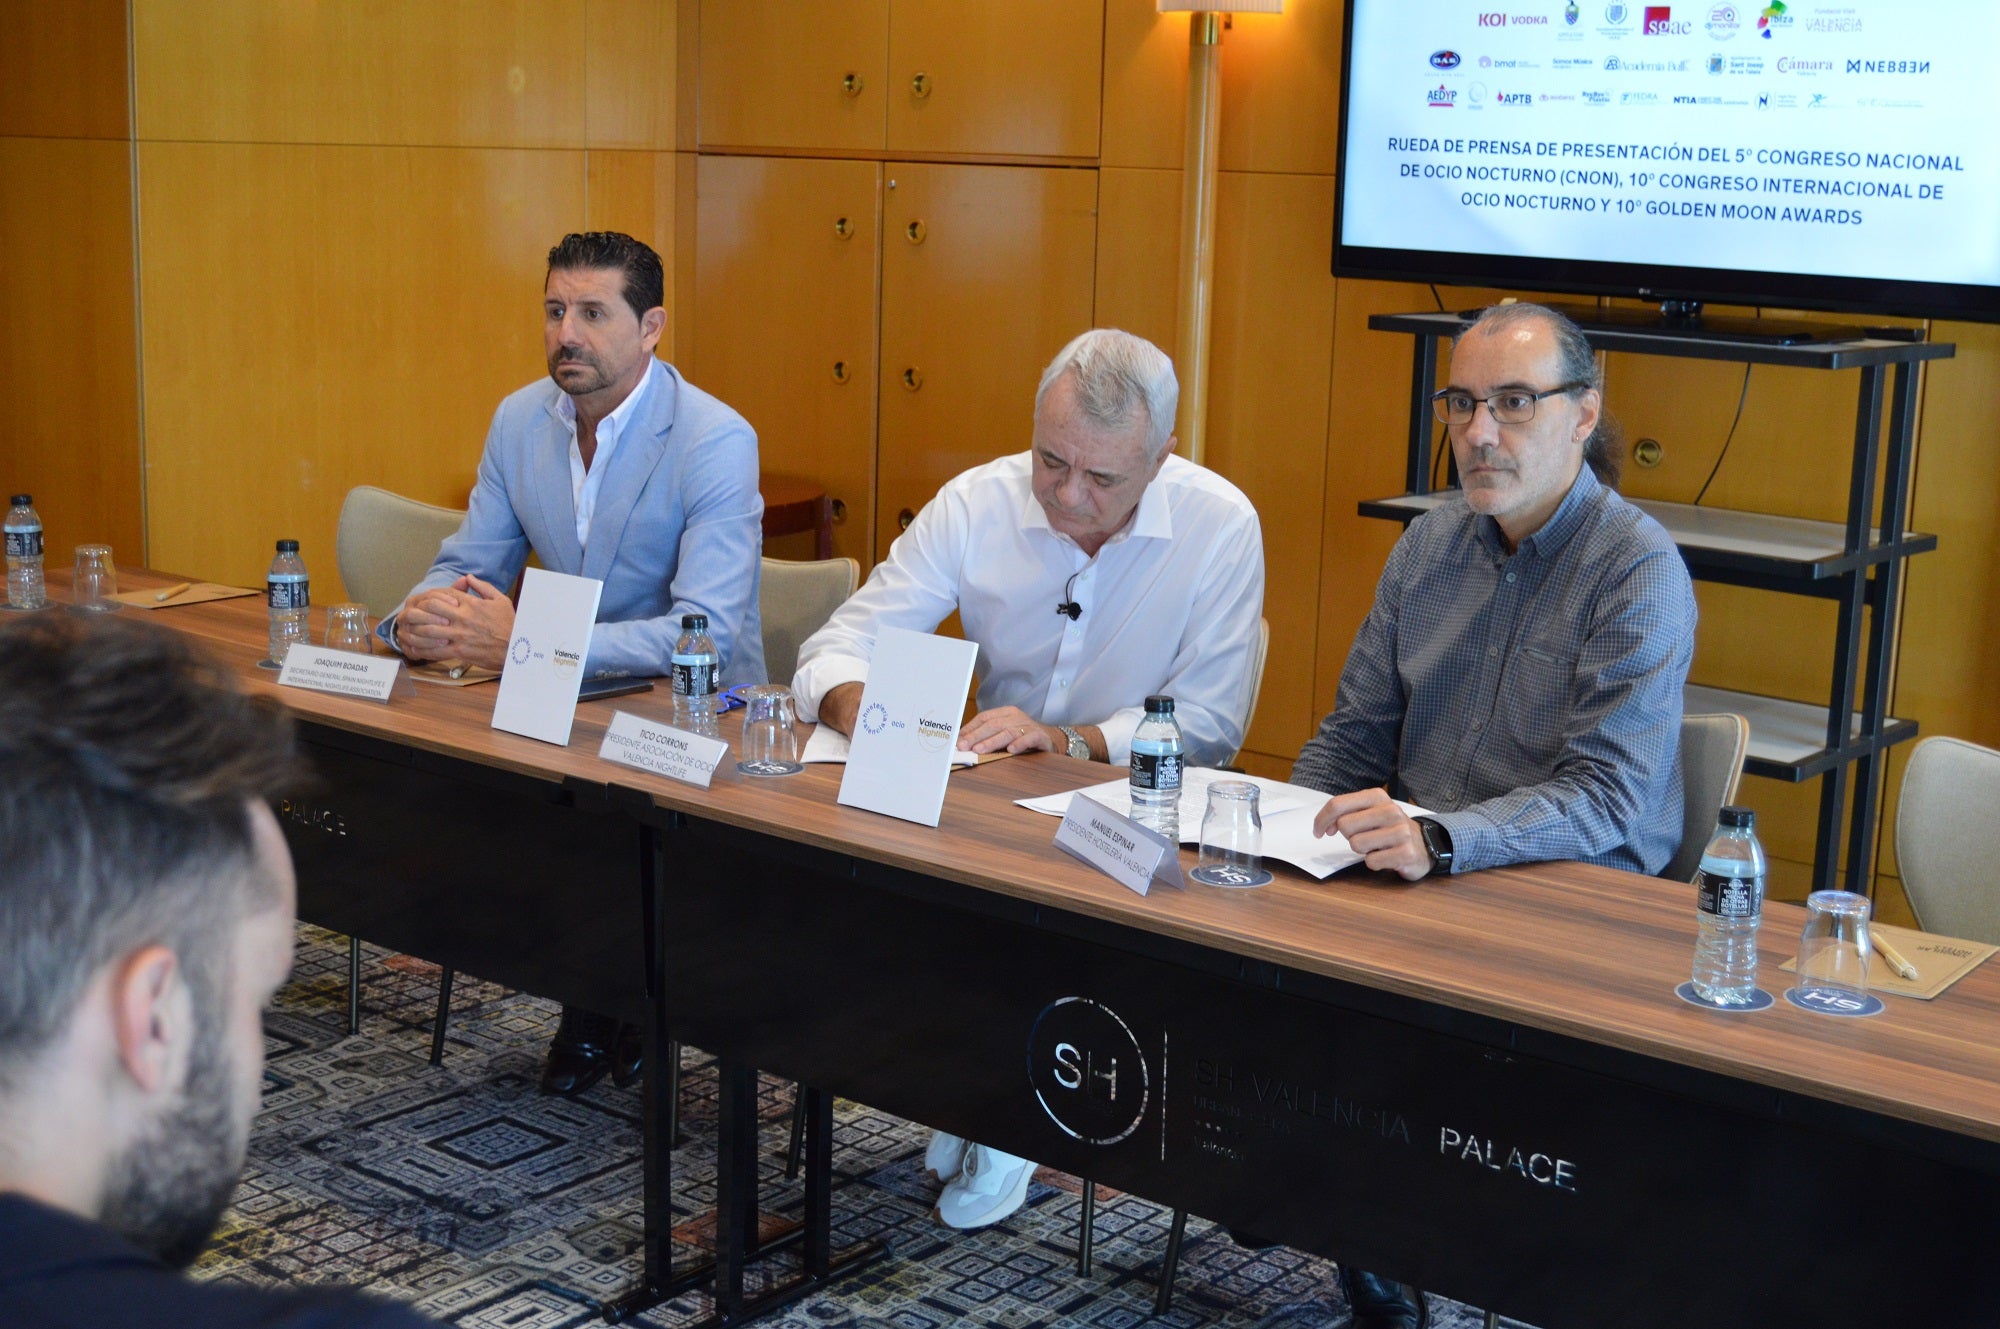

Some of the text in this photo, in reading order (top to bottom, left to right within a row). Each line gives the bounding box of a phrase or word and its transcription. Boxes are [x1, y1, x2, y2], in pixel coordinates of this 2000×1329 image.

[1478, 13, 1548, 27] KOI VODKA
[1648, 19, 1692, 36] sgae
[1388, 137, 1440, 152] RUEDA
[1444, 139, 1464, 153] DE
[1468, 140, 1532, 155] PRENSA
[1536, 142, 1558, 156] DE
[1562, 142, 1693, 161] PRESENTACIÓN
[1698, 147, 1730, 162] DEL
[1757, 149, 1861, 167] CONGRESO
[1866, 153, 1964, 171] NACIONAL
[1400, 164, 1420, 177] DE
[1423, 165, 1462, 179] OCIO
[1466, 166, 1556, 183] NOCTURNO
[1560, 169, 1623, 188] (CNON),
[1659, 173, 1758, 192] CONGRESO
[1763, 178, 1913, 198] INTERNACIONAL
[1918, 184, 1944, 200] DE
[1461, 192, 1501, 207] OCIO
[1504, 194, 1596, 212] NOCTURNO
[1601, 198, 1611, 212] Y
[1646, 200, 1716, 218] GOLDEN
[1721, 204, 1776, 221] MOON
[1781, 207, 1862, 225] AWARDS
[314, 657, 369, 673] JOAQUIM BOADAS
[554, 648, 580, 661] Valencia
[918, 727, 951, 740] Nightlife
[919, 717, 953, 732] Valencia
[605, 732, 642, 750] PRESIDENTE
[684, 756, 695, 766] DE
[639, 729, 689, 751] TICO CORRONS
[623, 750, 688, 778] VALENCIA NIGHTLIFE
[1063, 817, 1151, 880] PRESIDENTE HOSTELERÍA VALENCIA
[1089, 818, 1136, 853] MANUEL ESPINAR
[1054, 1042, 1117, 1100] SH
[1440, 1126, 1577, 1192] PALACE
